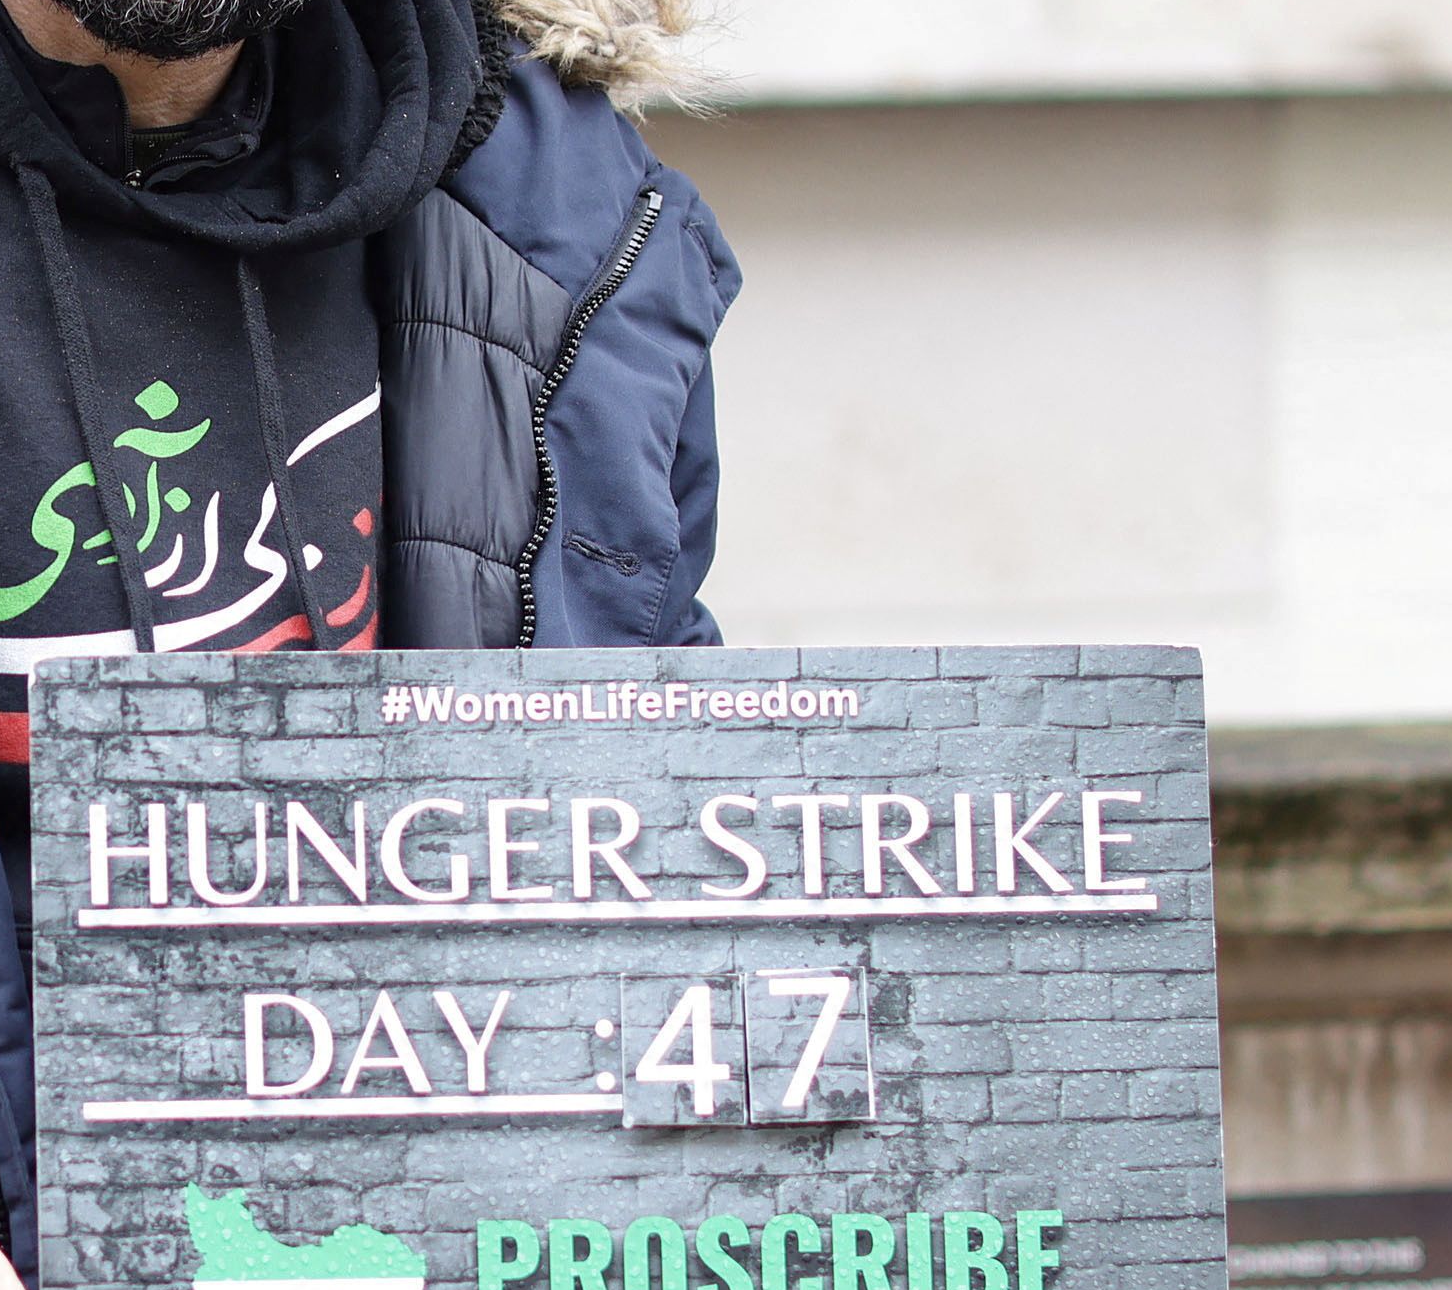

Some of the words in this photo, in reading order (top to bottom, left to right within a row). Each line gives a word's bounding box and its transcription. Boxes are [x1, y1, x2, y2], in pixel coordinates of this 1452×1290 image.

[381, 680, 860, 725] #WomenLifeFreedom
[88, 796, 653, 907] HUNGER
[701, 789, 1149, 901] STRIKE
[242, 988, 513, 1099] DAY
